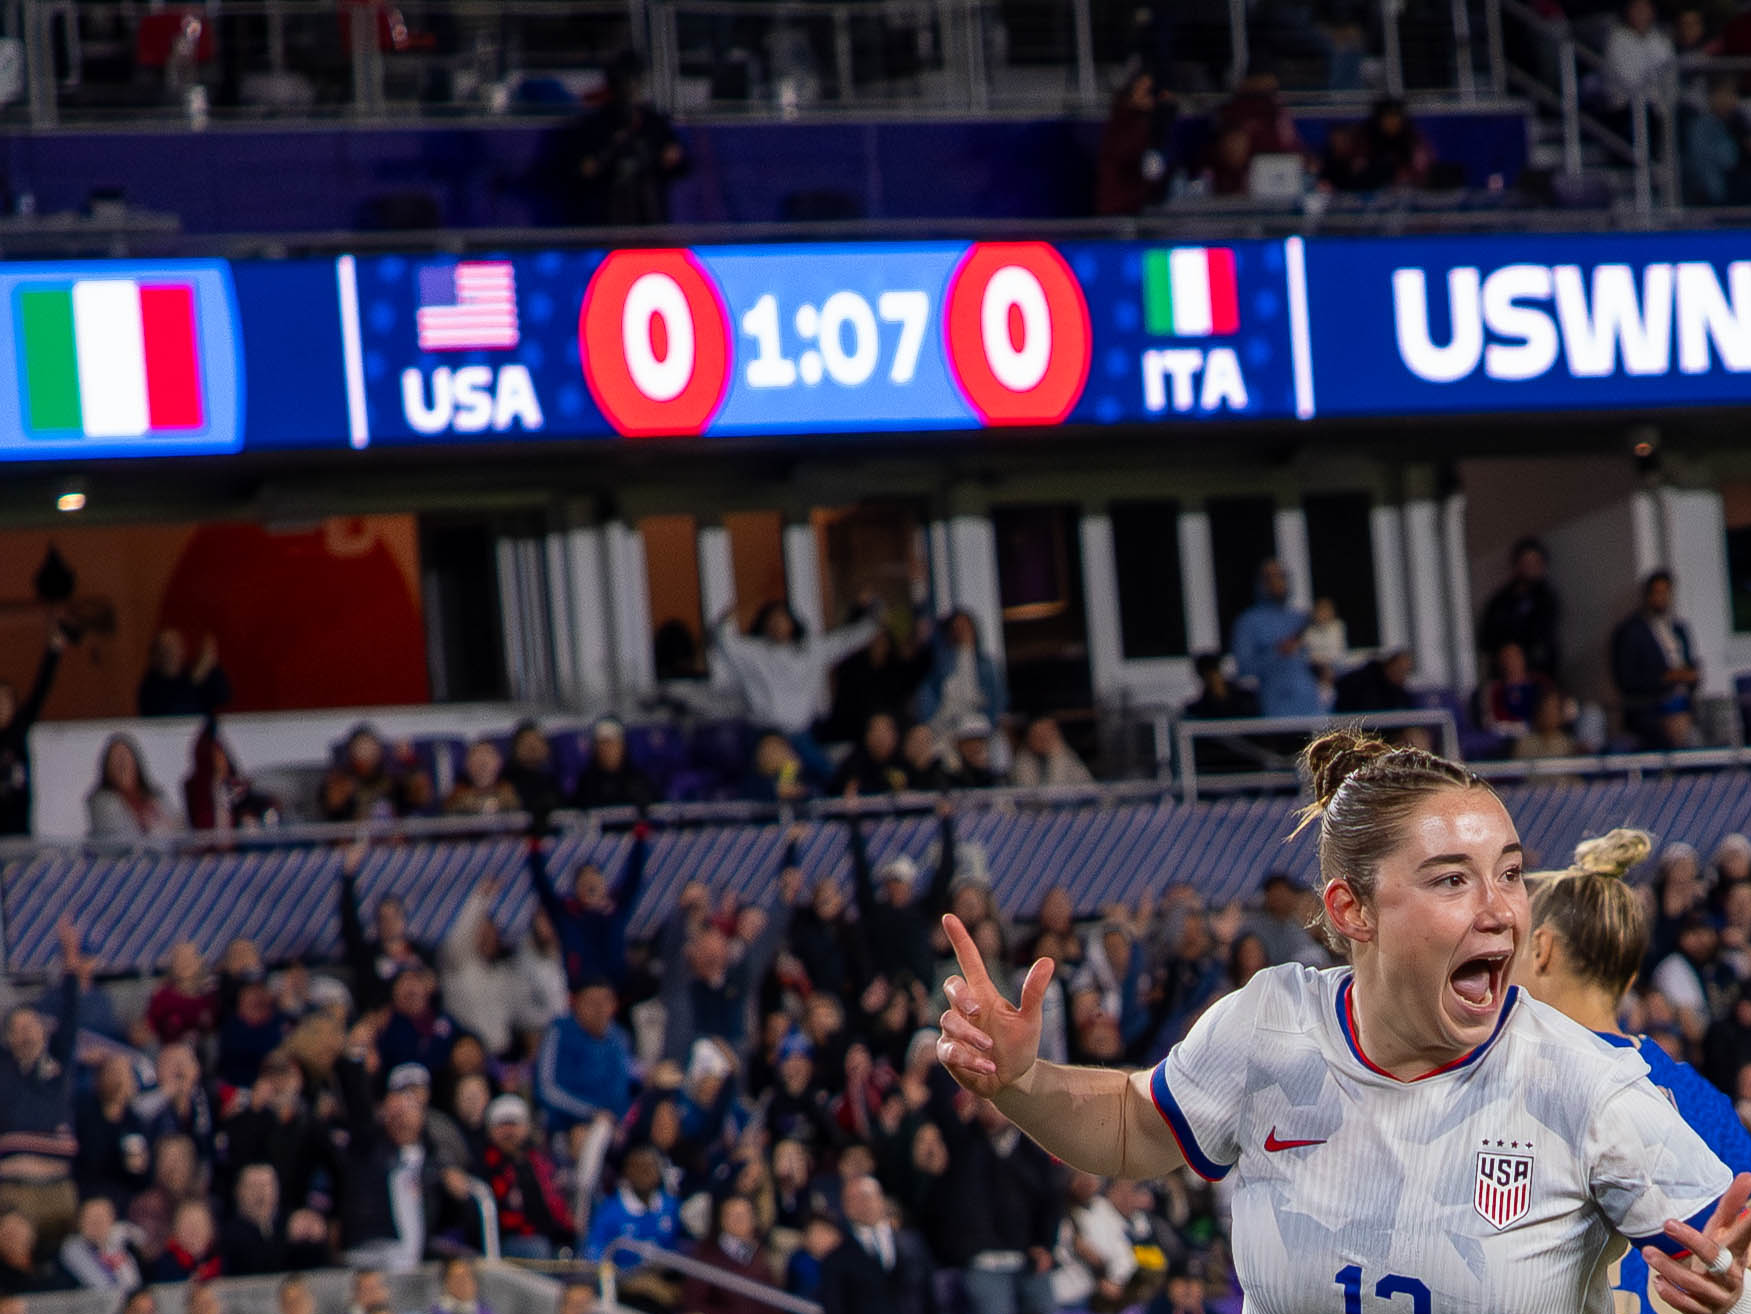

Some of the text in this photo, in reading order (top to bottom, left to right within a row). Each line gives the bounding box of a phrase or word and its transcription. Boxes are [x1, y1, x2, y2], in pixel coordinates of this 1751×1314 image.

[623, 273, 694, 400] 0
[742, 291, 929, 388] 1:07
[982, 266, 1051, 391] 0
[402, 365, 542, 433] USA
[1142, 348, 1248, 410] ITA
[1480, 1157, 1529, 1187] USA
